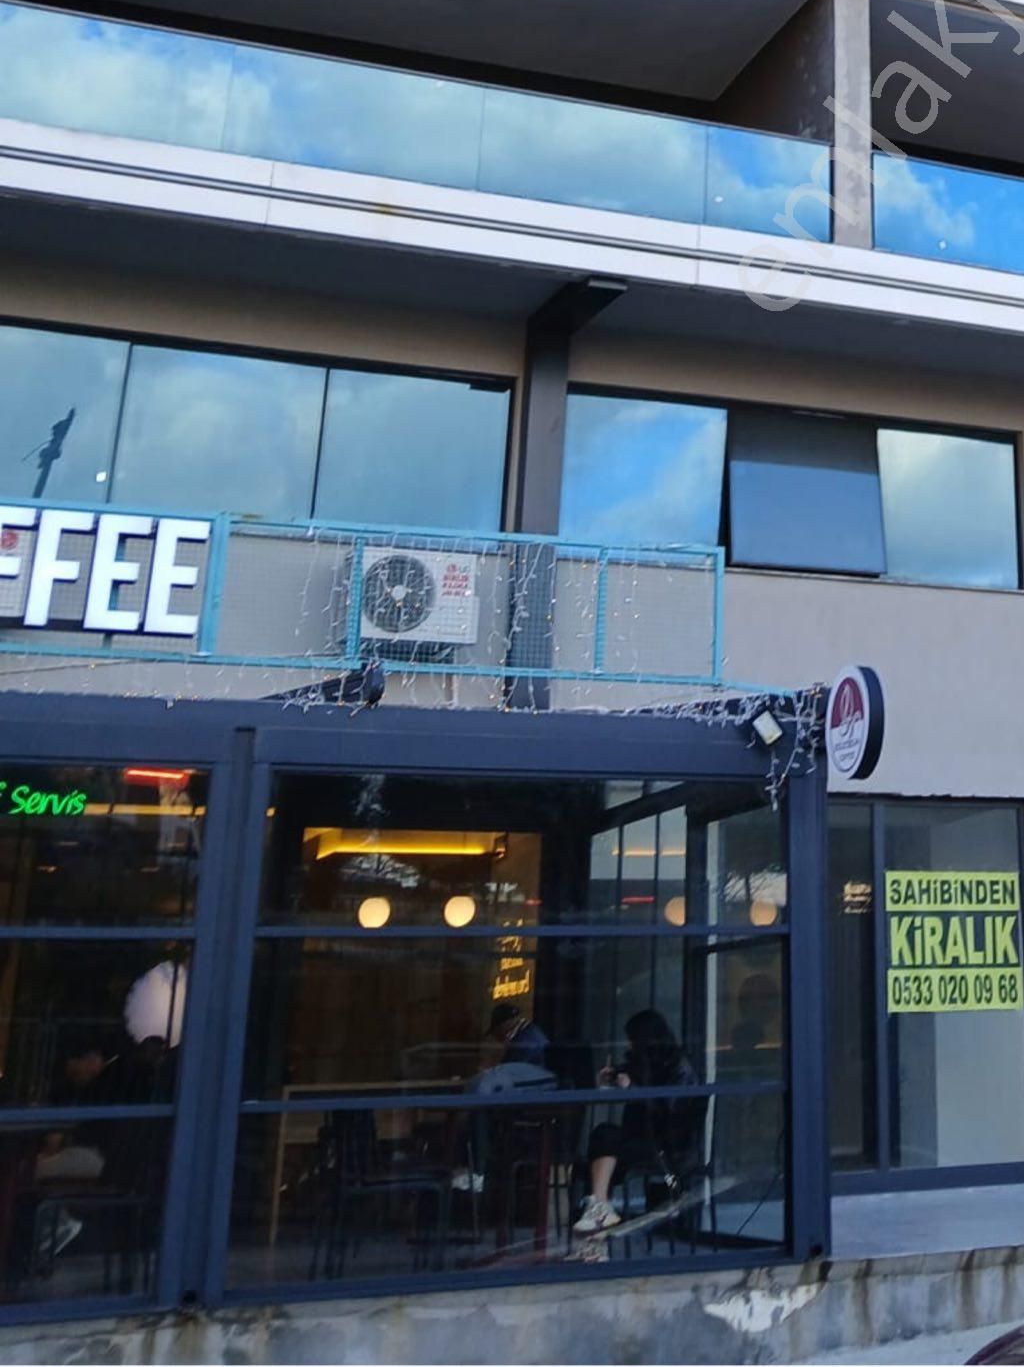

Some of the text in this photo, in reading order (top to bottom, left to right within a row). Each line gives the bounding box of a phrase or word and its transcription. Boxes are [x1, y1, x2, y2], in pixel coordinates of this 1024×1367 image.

[8, 785, 87, 815] Servis
[892, 973, 1018, 1006] 0533 020 09 68
